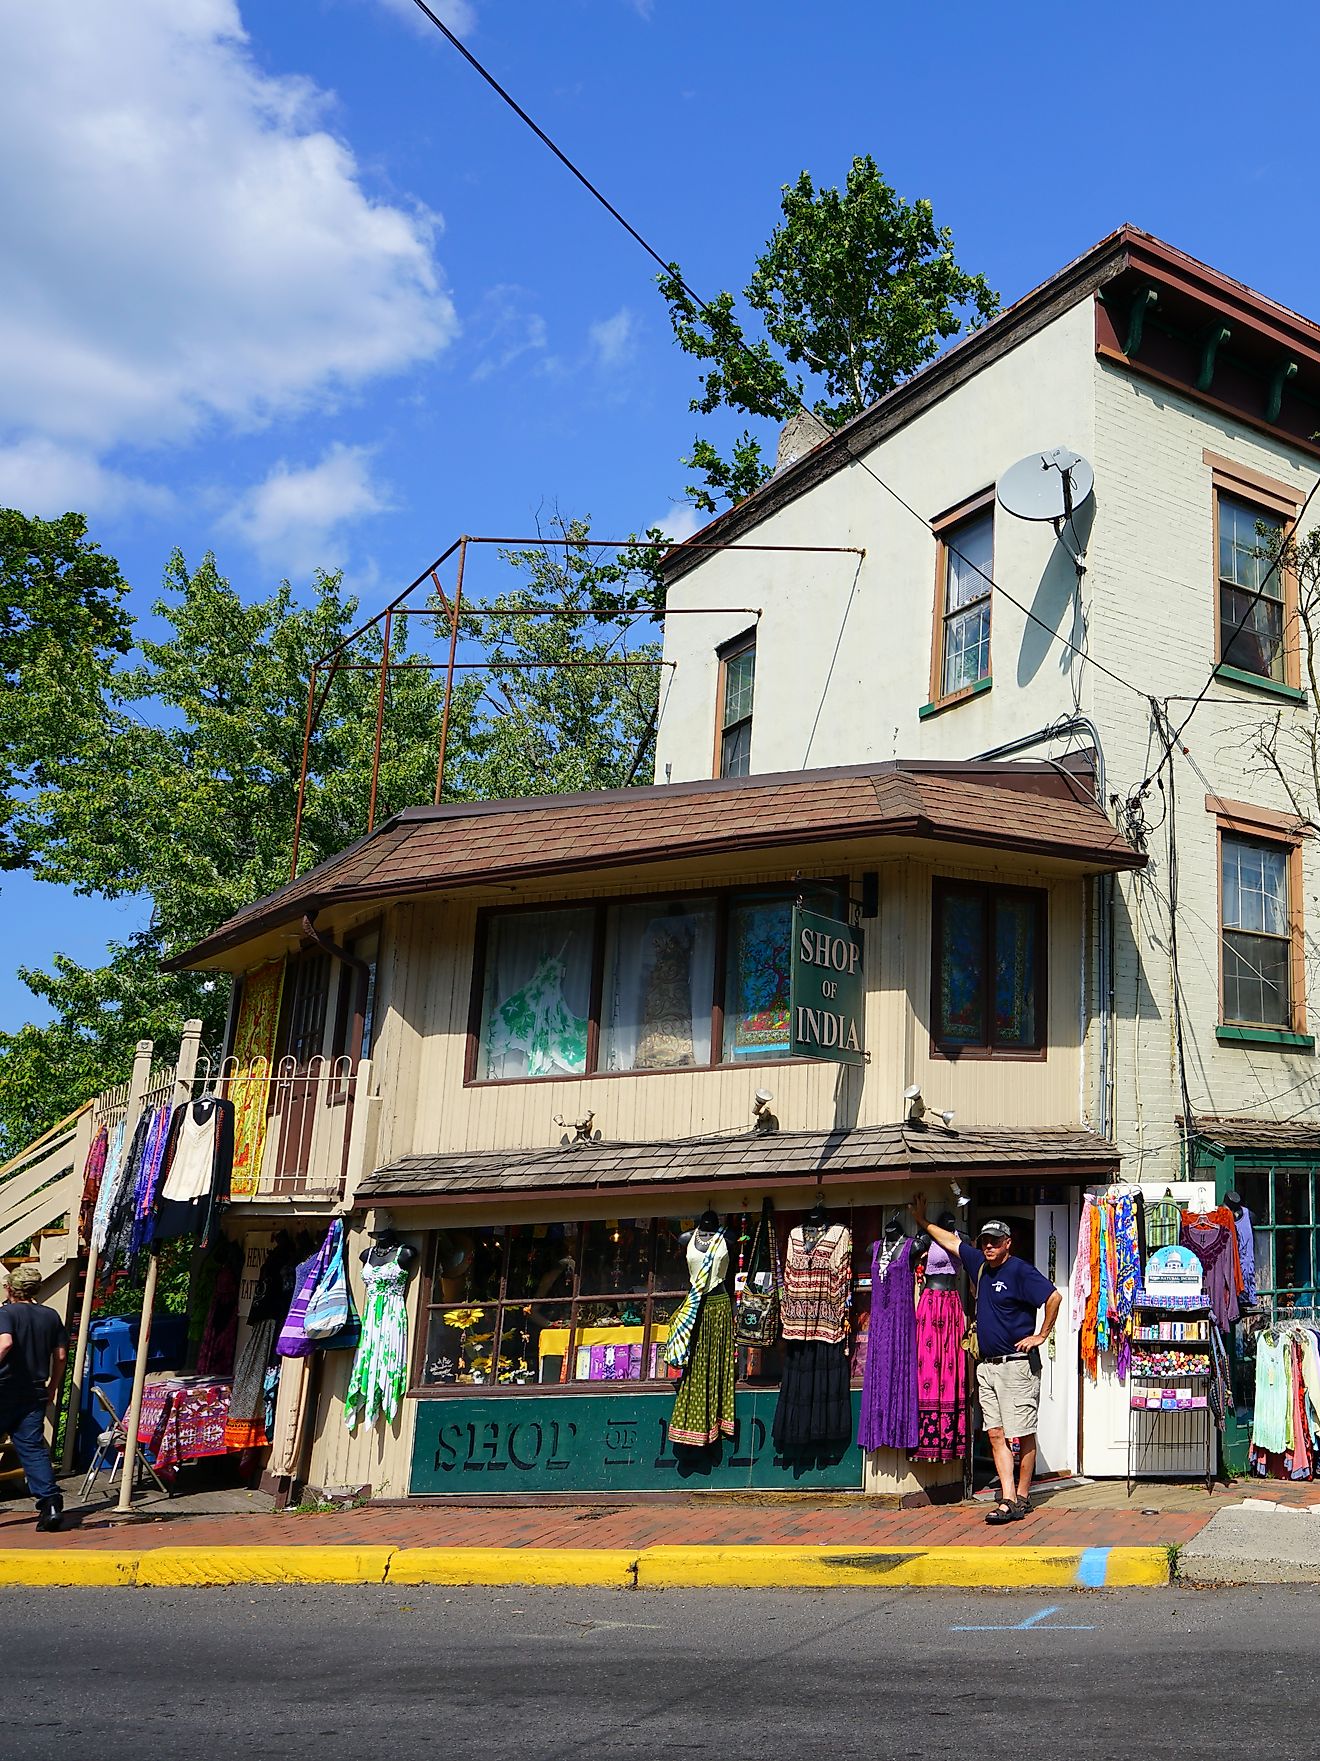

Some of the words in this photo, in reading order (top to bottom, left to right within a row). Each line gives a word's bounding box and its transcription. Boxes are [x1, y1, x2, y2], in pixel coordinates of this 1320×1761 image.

[800, 927, 860, 975] SHOP
[822, 980, 838, 999] OF
[796, 1006, 862, 1053] INDIA
[434, 1419, 577, 1472] SHOP
